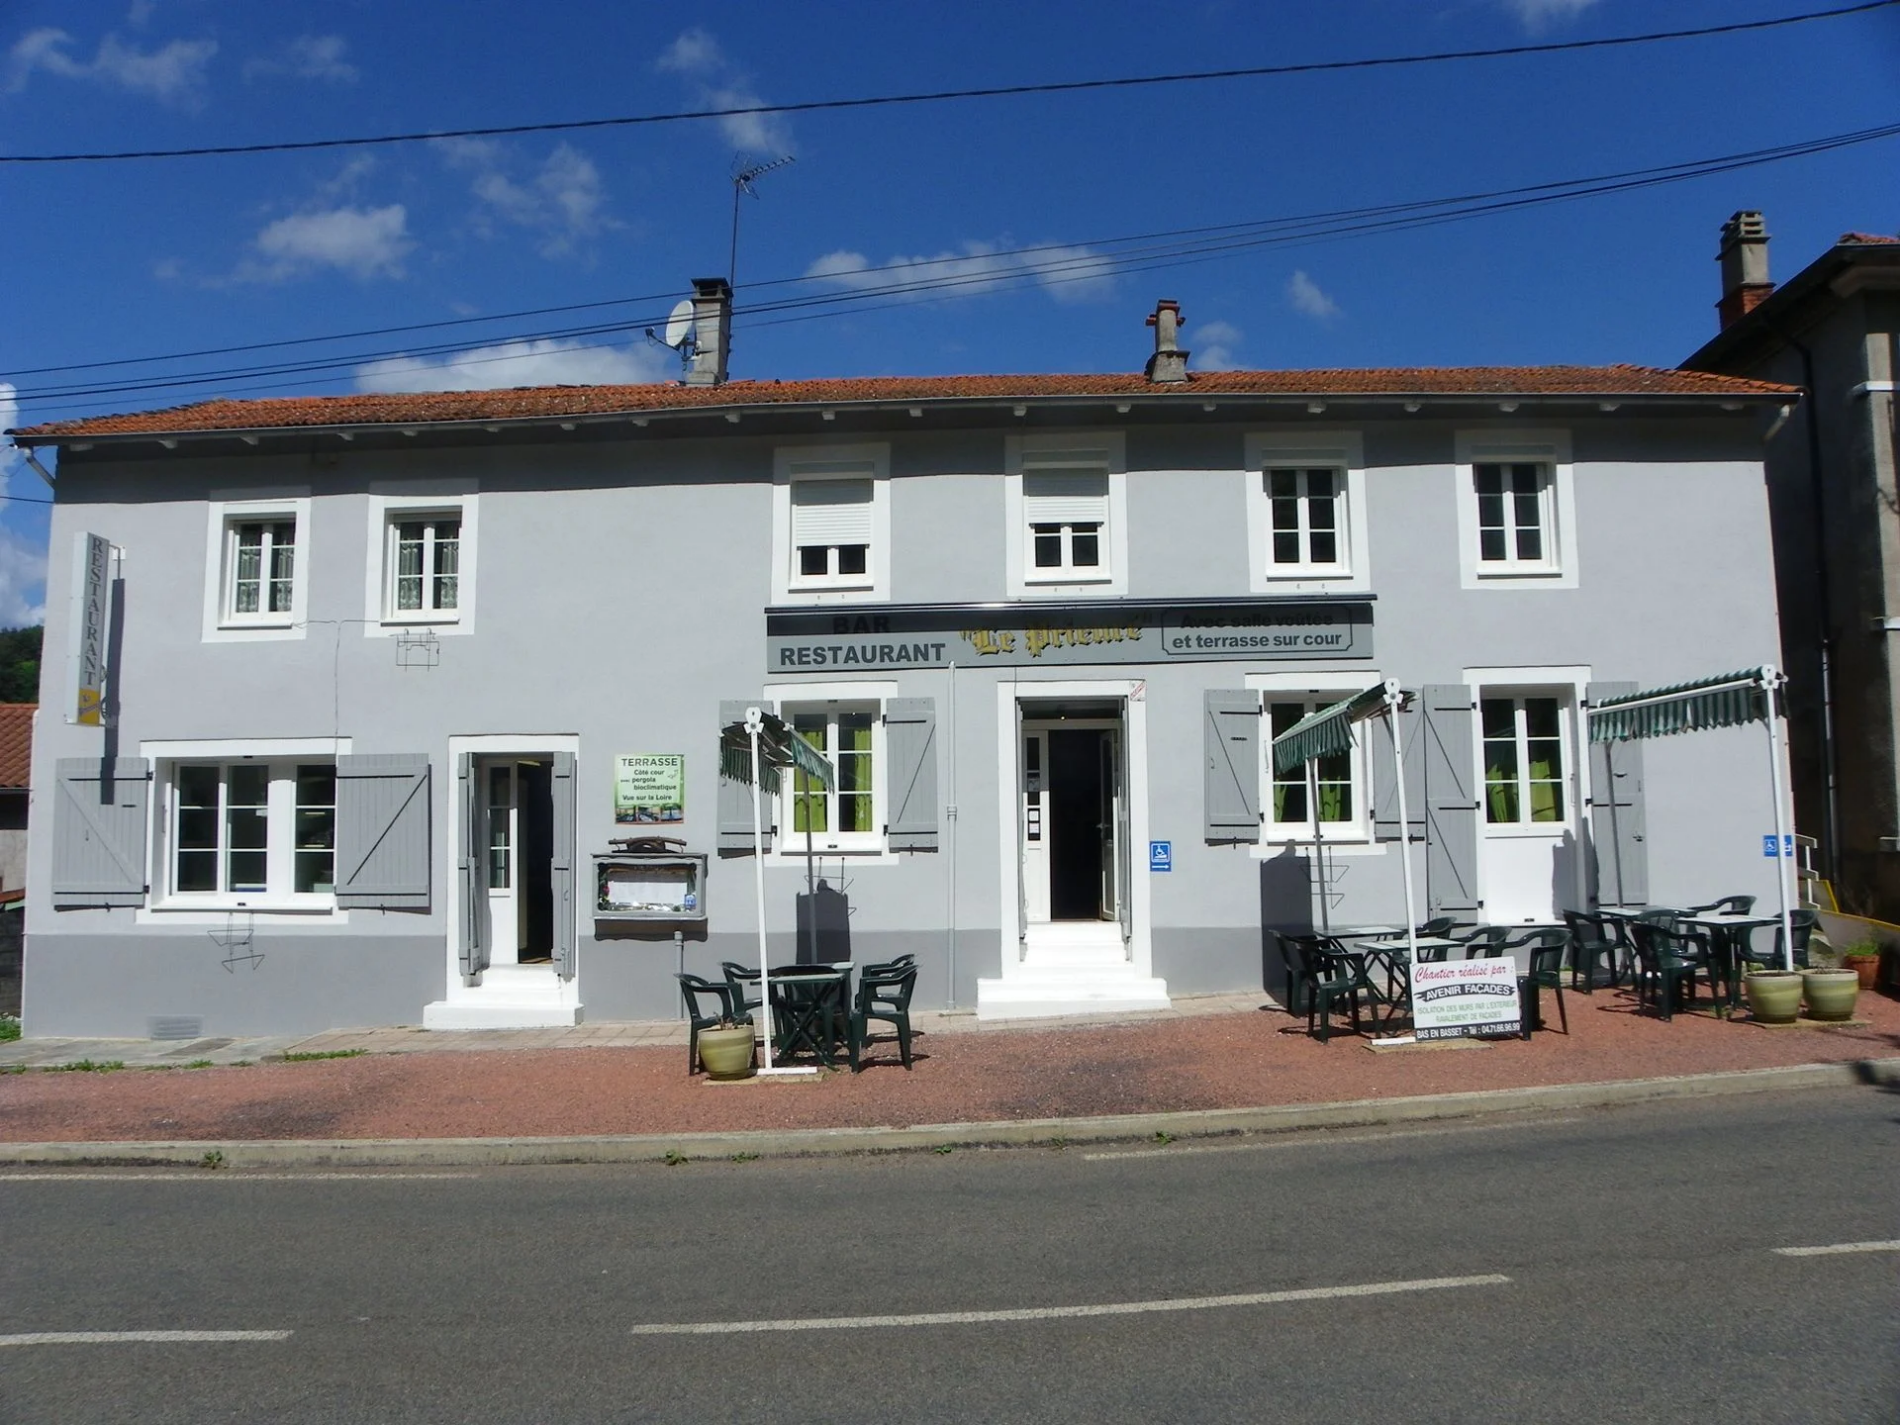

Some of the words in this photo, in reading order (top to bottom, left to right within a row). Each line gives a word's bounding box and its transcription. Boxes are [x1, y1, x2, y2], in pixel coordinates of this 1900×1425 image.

[84, 537, 103, 686] RESTAURANT
[833, 615, 890, 635] BAR
[1180, 613, 1224, 629] Avec
[1230, 613, 1271, 628] salle
[1172, 635, 1192, 649] et
[1196, 634, 1270, 648] terrasse
[1273, 635, 1300, 646] sur
[1303, 633, 1342, 646] cour
[780, 643, 946, 666] RESTAURANT
[621, 758, 678, 767] TERRASSE
[1415, 967, 1455, 983] Chantier
[1459, 963, 1488, 977] réalisé
[1491, 965, 1507, 978] par
[1426, 985, 1462, 1001] AVENIR
[1465, 983, 1511, 996] FAÇADES
[1417, 1003, 1445, 1015] ISOLATION
[1446, 1003, 1459, 1013] DES
[1460, 1002, 1474, 1012] MURS
[1475, 1001, 1486, 1010] PAR
[1436, 1013, 1468, 1023] RAVALEMENT
[1470, 1012, 1478, 1020] DE
[1417, 1029, 1429, 1039] BAS
[1430, 1028, 1439, 1038] EN
[1440, 1027, 1462, 1037] BASSET
